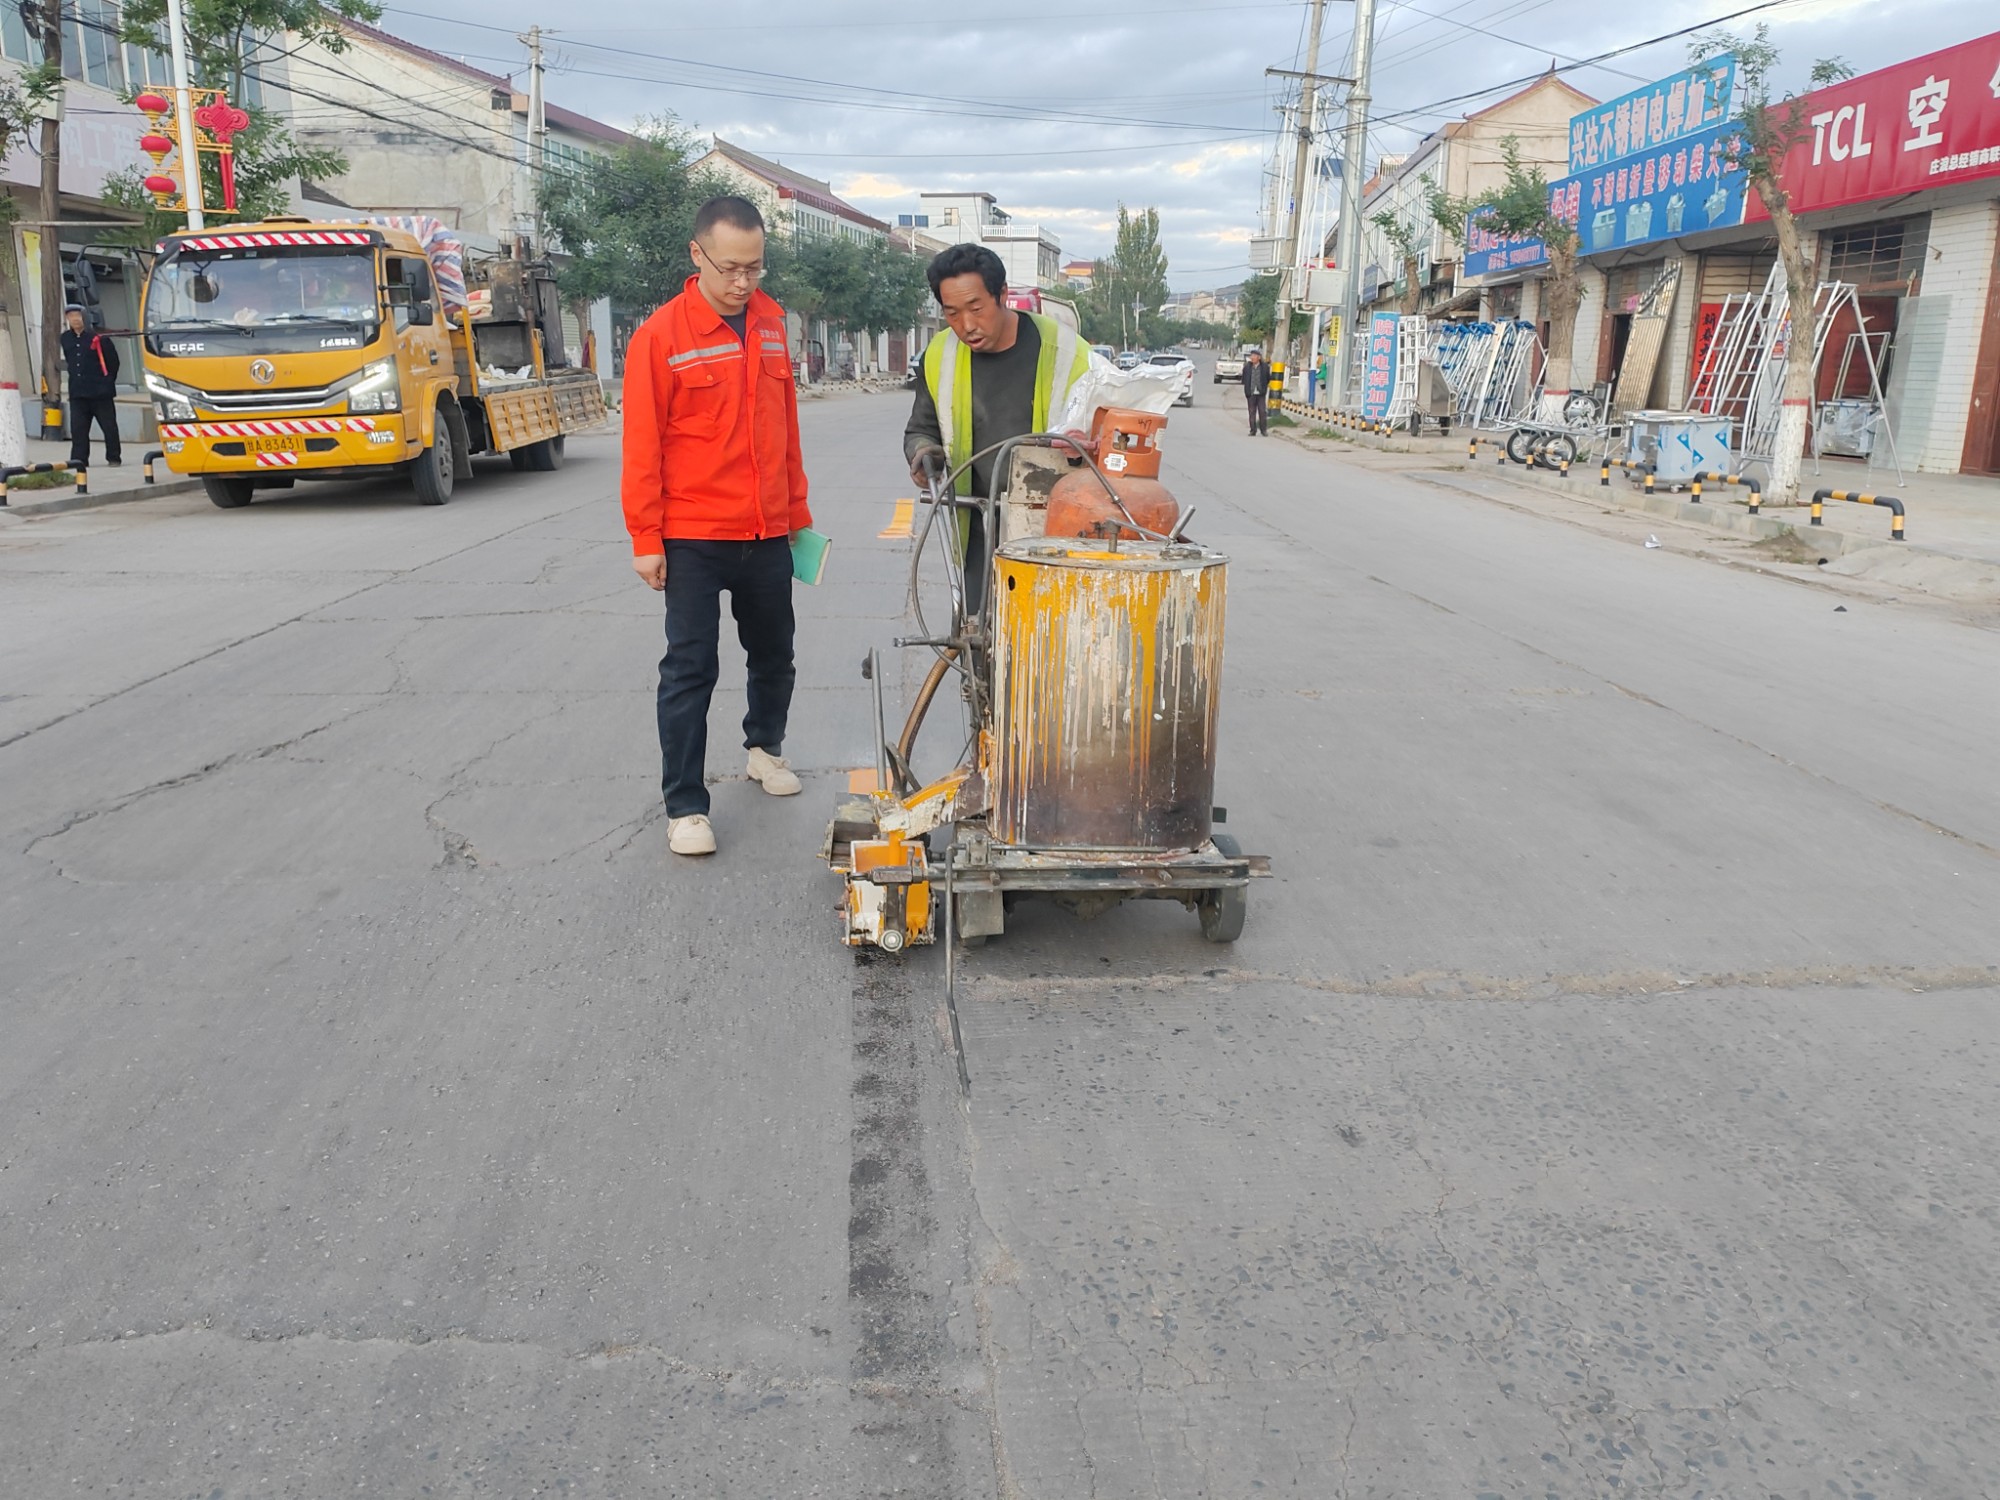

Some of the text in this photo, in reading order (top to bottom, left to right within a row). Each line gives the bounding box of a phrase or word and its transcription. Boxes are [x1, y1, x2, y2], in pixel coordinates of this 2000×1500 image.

[1571, 67, 1729, 171] 兴达不锈钢电焊加工
[1811, 103, 1872, 166] TCL
[169, 343, 205, 352] DFAC
[1366, 319, 1395, 419] 院内电焊加工
